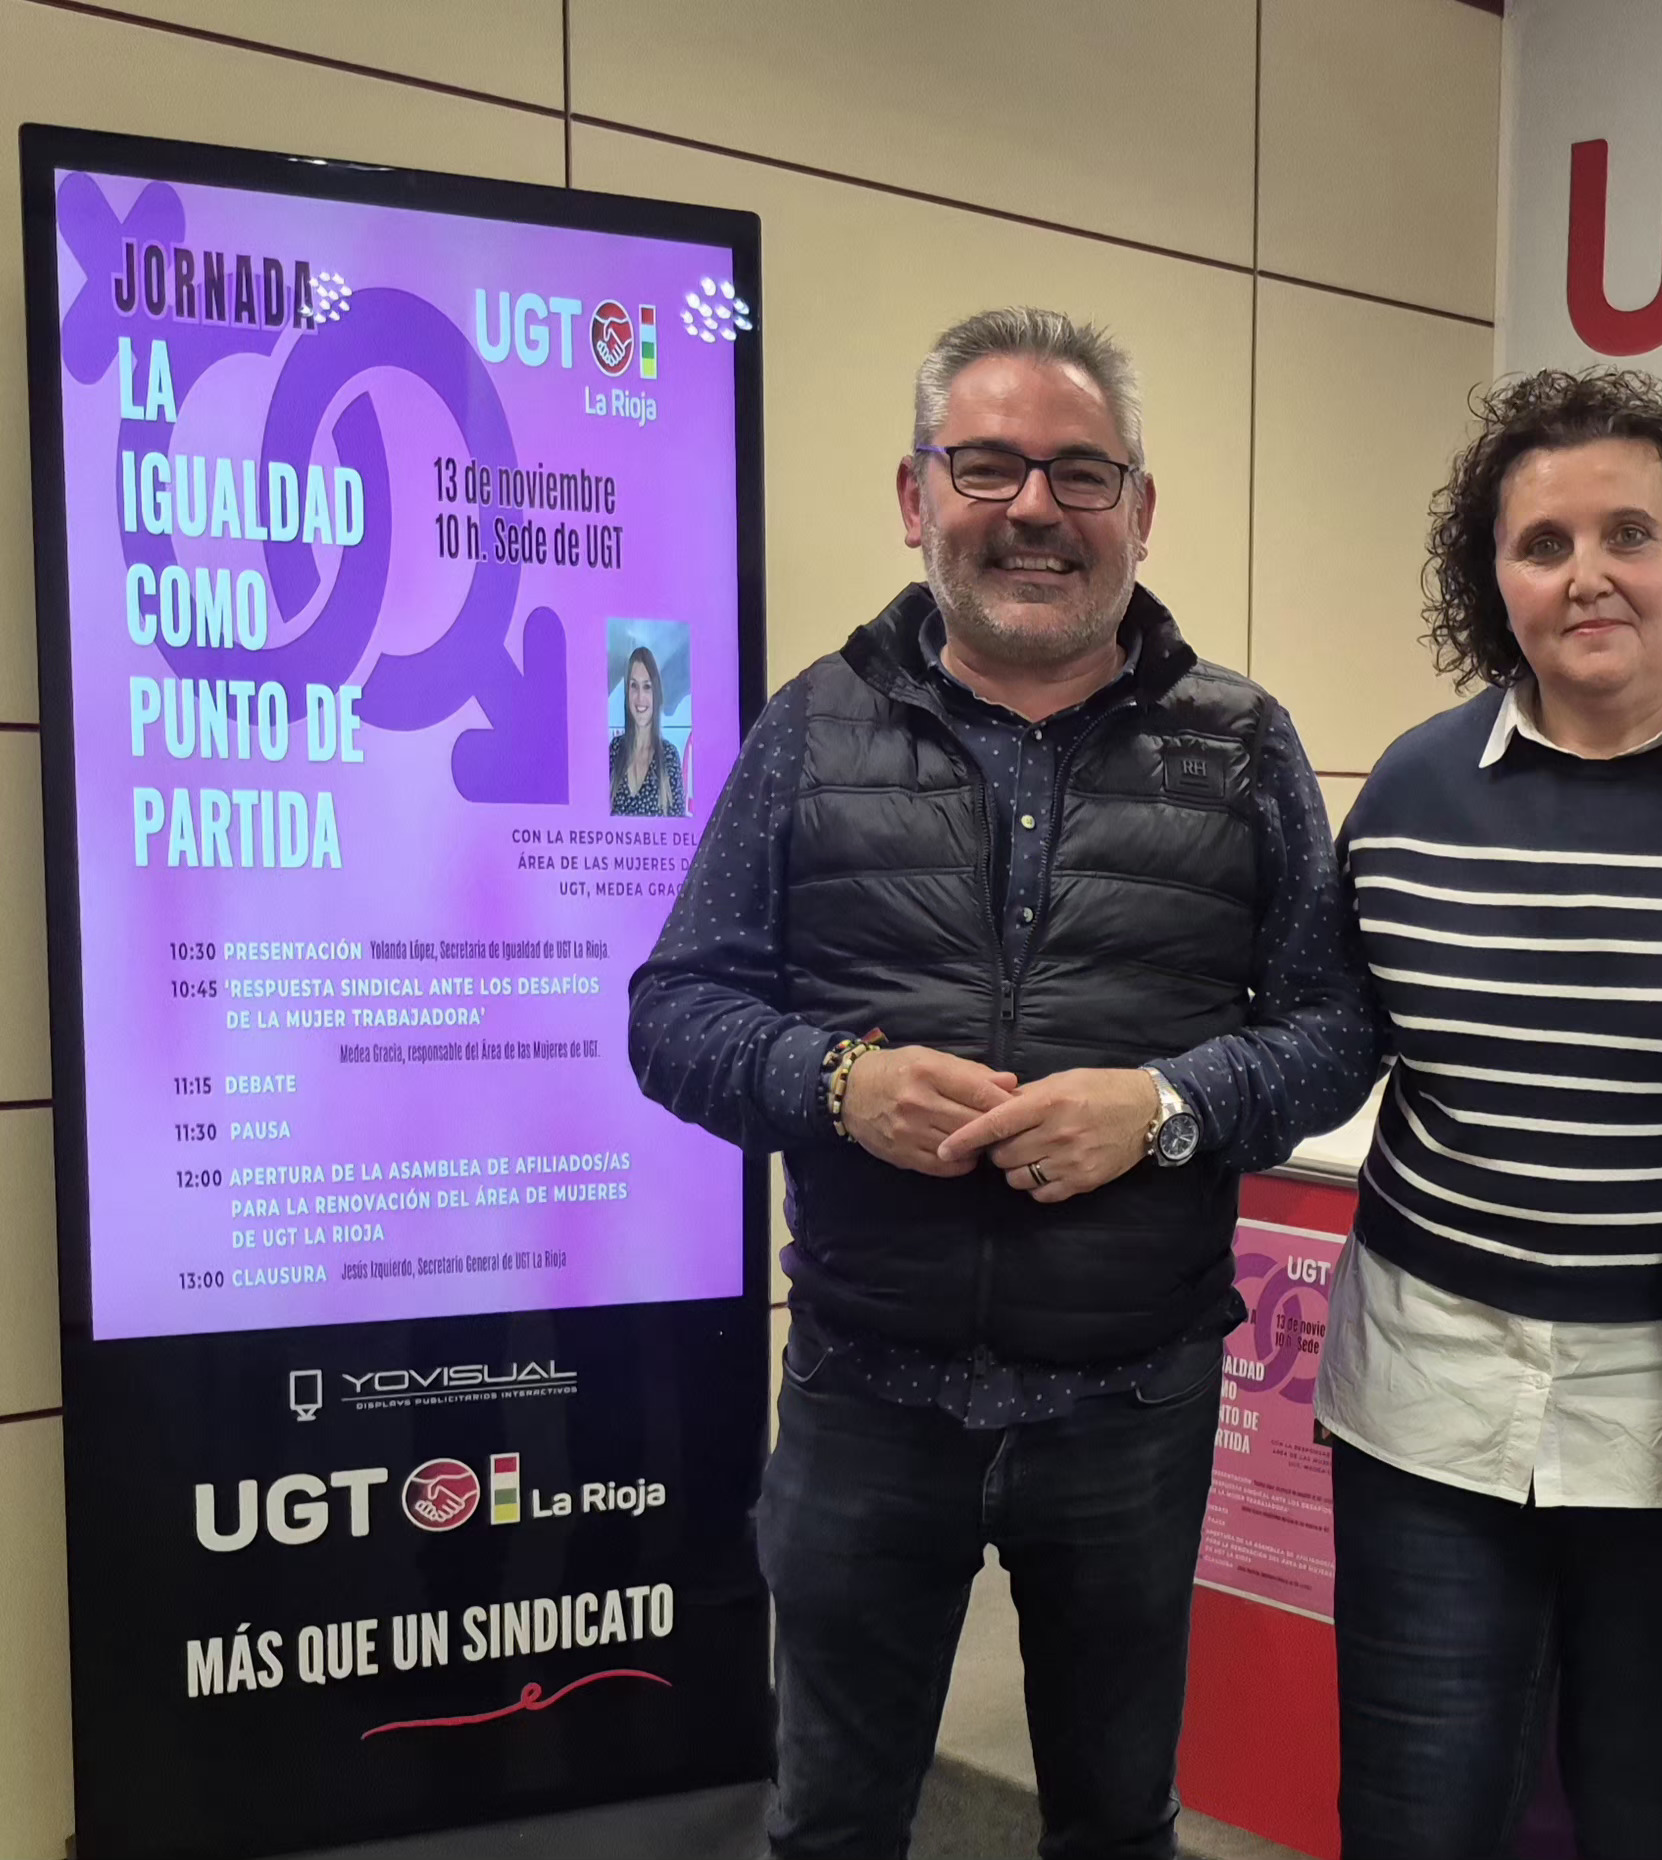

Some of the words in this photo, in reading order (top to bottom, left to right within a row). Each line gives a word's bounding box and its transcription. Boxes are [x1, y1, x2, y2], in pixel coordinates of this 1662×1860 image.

[114, 241, 316, 331] JORNADA
[475, 288, 583, 369] UGT
[118, 336, 177, 424] LA
[585, 386, 607, 417] La
[612, 388, 657, 428] Rioja
[121, 450, 365, 547] IGUALDAD
[433, 456, 458, 503] 13
[464, 459, 491, 506] de
[499, 462, 616, 515] noviembre
[435, 512, 460, 560] 10
[467, 515, 488, 562] h.
[494, 517, 548, 566] Sede
[554, 522, 580, 568] de
[586, 524, 624, 570] UGT
[126, 563, 268, 651] COMO
[130, 675, 289, 762] PUNTO
[306, 683, 365, 763] DE
[133, 787, 343, 869] PARTIDA
[512, 829, 541, 844] CON
[547, 830, 564, 844] LA
[569, 830, 668, 846] RESPONSABLE
[673, 832, 698, 846] DEL
[518, 852, 555, 870] ÁREA
[561, 856, 578, 870] DE
[584, 856, 609, 871] LAS
[614, 857, 676, 871] MUJERES
[681, 857, 691, 871] D
[560, 881, 590, 899] UGT,
[596, 882, 643, 897] MEDEA
[170, 942, 216, 961] 10:30
[224, 938, 363, 961] PRESENTACIÓN
[370, 940, 407, 961] Yolanda
[409, 939, 438, 962] López,
[440, 939, 486, 960] Secretaria
[488, 939, 500, 959] de
[502, 939, 541, 961] Igualdad
[543, 939, 554, 959] de
[556, 939, 571, 959] UGT
[573, 939, 583, 959] La
[171, 980, 218, 999] 10:45
[225, 978, 335, 999] 'RESPUESTA
[341, 977, 424, 997] SINDICAL
[429, 977, 474, 996] ANTE
[480, 977, 512, 996] LOS
[518, 973, 600, 995] DESAFÍOS
[227, 1010, 251, 1029] DE
[258, 1010, 280, 1029] LA
[286, 1009, 346, 1028] MUJER
[351, 1007, 486, 1028] TRABAJADORA'
[340, 1043, 370, 1064] Medea
[373, 1043, 406, 1065] Gracia,
[408, 1041, 463, 1065] responsable
[465, 1041, 479, 1061] del
[482, 1039, 501, 1061] Área
[504, 1041, 516, 1060] de
[518, 1040, 531, 1060] las
[533, 1040, 568, 1062] Mujeres
[570, 1040, 581, 1059] de
[174, 1077, 212, 1095] 11:15
[225, 1075, 297, 1094] DEBATE
[175, 1123, 217, 1142] 11:30
[230, 1120, 291, 1140] PAUSA
[176, 1169, 222, 1188] 12:00
[229, 1165, 325, 1187] APERTURA
[332, 1163, 355, 1183] DE
[361, 1163, 383, 1181] LA
[389, 1158, 482, 1180] ASAMBLEA
[488, 1157, 509, 1176] DE
[515, 1152, 631, 1174] AFILIADOS/AS
[231, 1198, 281, 1218] PARA
[287, 1197, 309, 1216] LA
[315, 1188, 431, 1214] RENOVACIÓN
[438, 1190, 470, 1208] DEL
[475, 1185, 520, 1207] ÁREA
[526, 1186, 547, 1204] DE
[554, 1182, 628, 1202] MUJERES
[232, 1230, 256, 1249] DE
[263, 1227, 298, 1247] UGT
[304, 1226, 326, 1245] LA
[332, 1223, 385, 1243] RIOJA
[179, 1270, 225, 1290] 13:00
[232, 1264, 328, 1287] CLAUSURA
[341, 1260, 368, 1280] Jesús
[370, 1258, 416, 1281] Izquierdo,
[418, 1254, 464, 1275] Secretario
[466, 1252, 500, 1273] General
[502, 1252, 514, 1270] de
[515, 1251, 531, 1269] UGT
[533, 1250, 543, 1269] La
[545, 1249, 567, 1270] Rioja
[1287, 1255, 1332, 1286] UGT
[1300, 1320, 1326, 1338] novie
[1297, 1336, 1320, 1354] Sede
[341, 1360, 578, 1393] YOVISUAL
[1222, 1355, 1265, 1382] ALDAD
[356, 1399, 411, 1410] DISPLAYS
[415, 1392, 498, 1405] PUBLICITARIOS
[501, 1386, 578, 1398] INTERACTIVOS
[1243, 1409, 1260, 1432] DE
[1215, 1428, 1251, 1454] RTIDA
[194, 1467, 389, 1552] UGT
[531, 1489, 572, 1518] La
[582, 1479, 666, 1516] Rioja
[186, 1622, 283, 1698] MÁS
[298, 1619, 379, 1686] QUE
[392, 1610, 448, 1671] UN
[462, 1583, 675, 1662] SINDICATO
